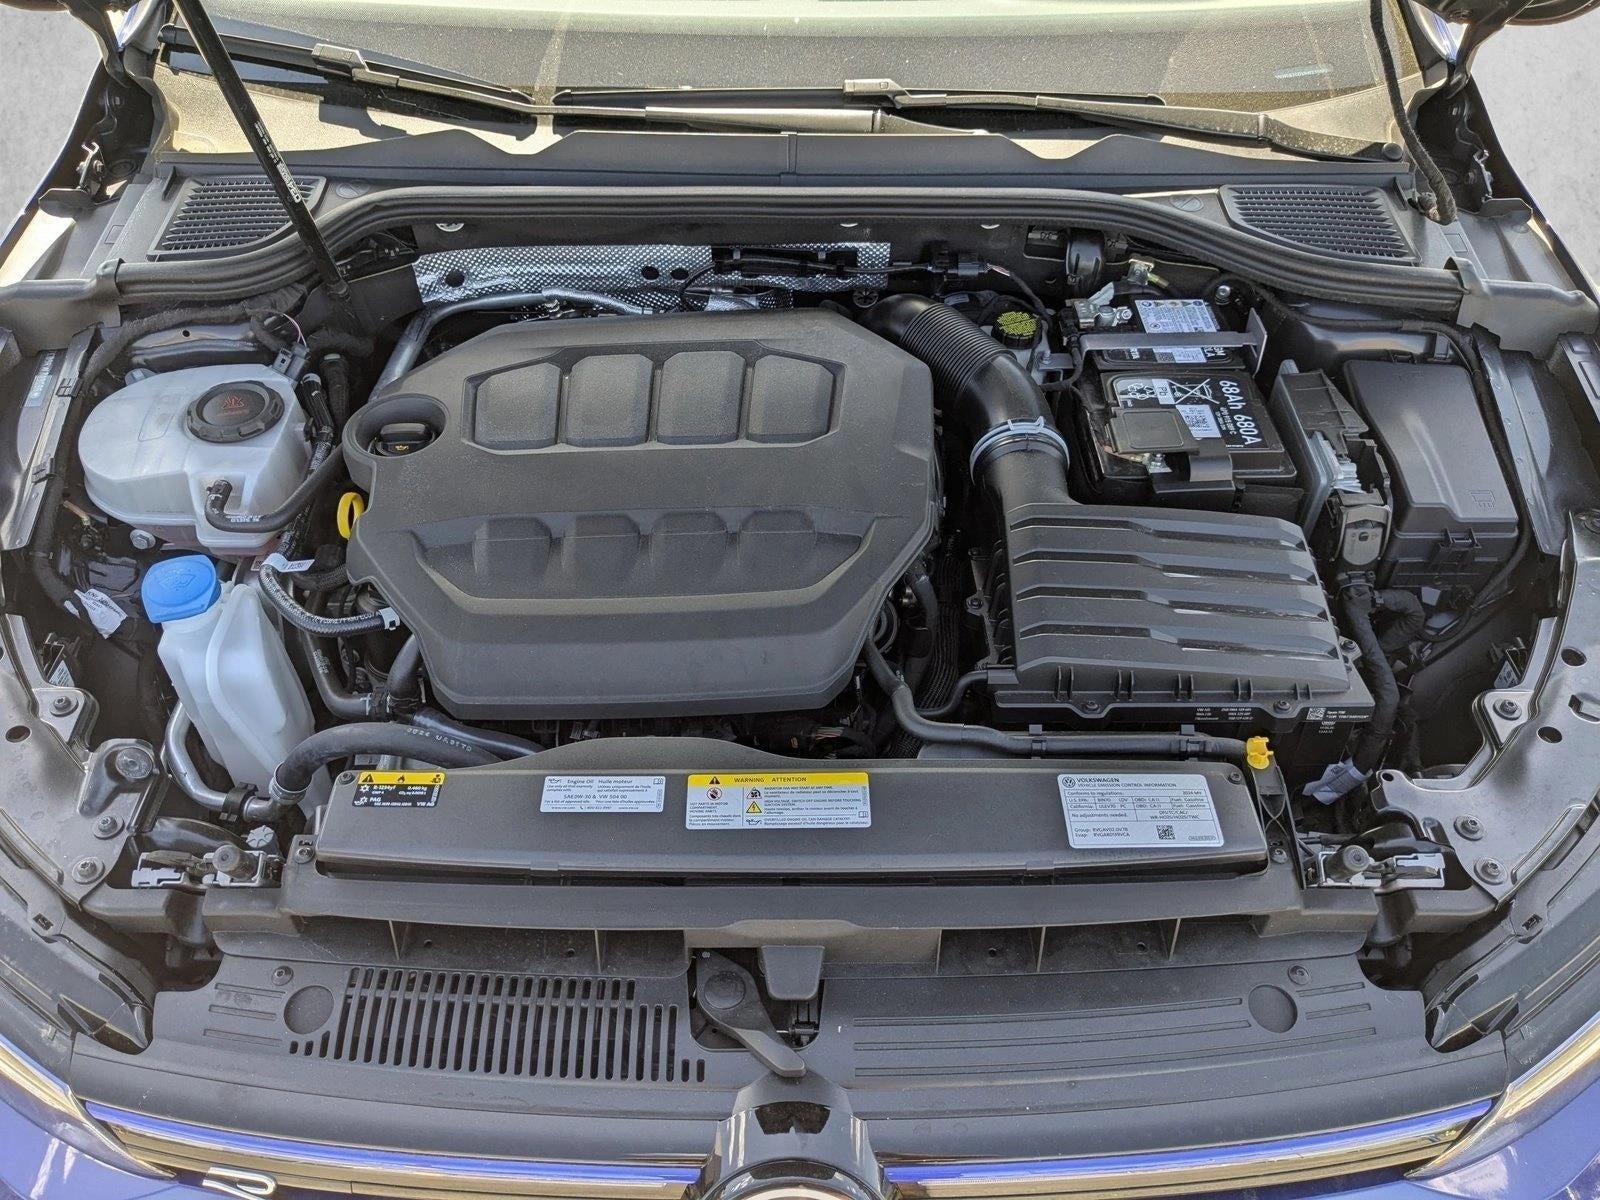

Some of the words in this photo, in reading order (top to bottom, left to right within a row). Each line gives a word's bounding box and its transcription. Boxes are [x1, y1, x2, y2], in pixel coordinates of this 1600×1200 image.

[1158, 386, 1169, 397] Pb
[1219, 380, 1246, 410] 68Ah
[1234, 414, 1262, 445] 680A
